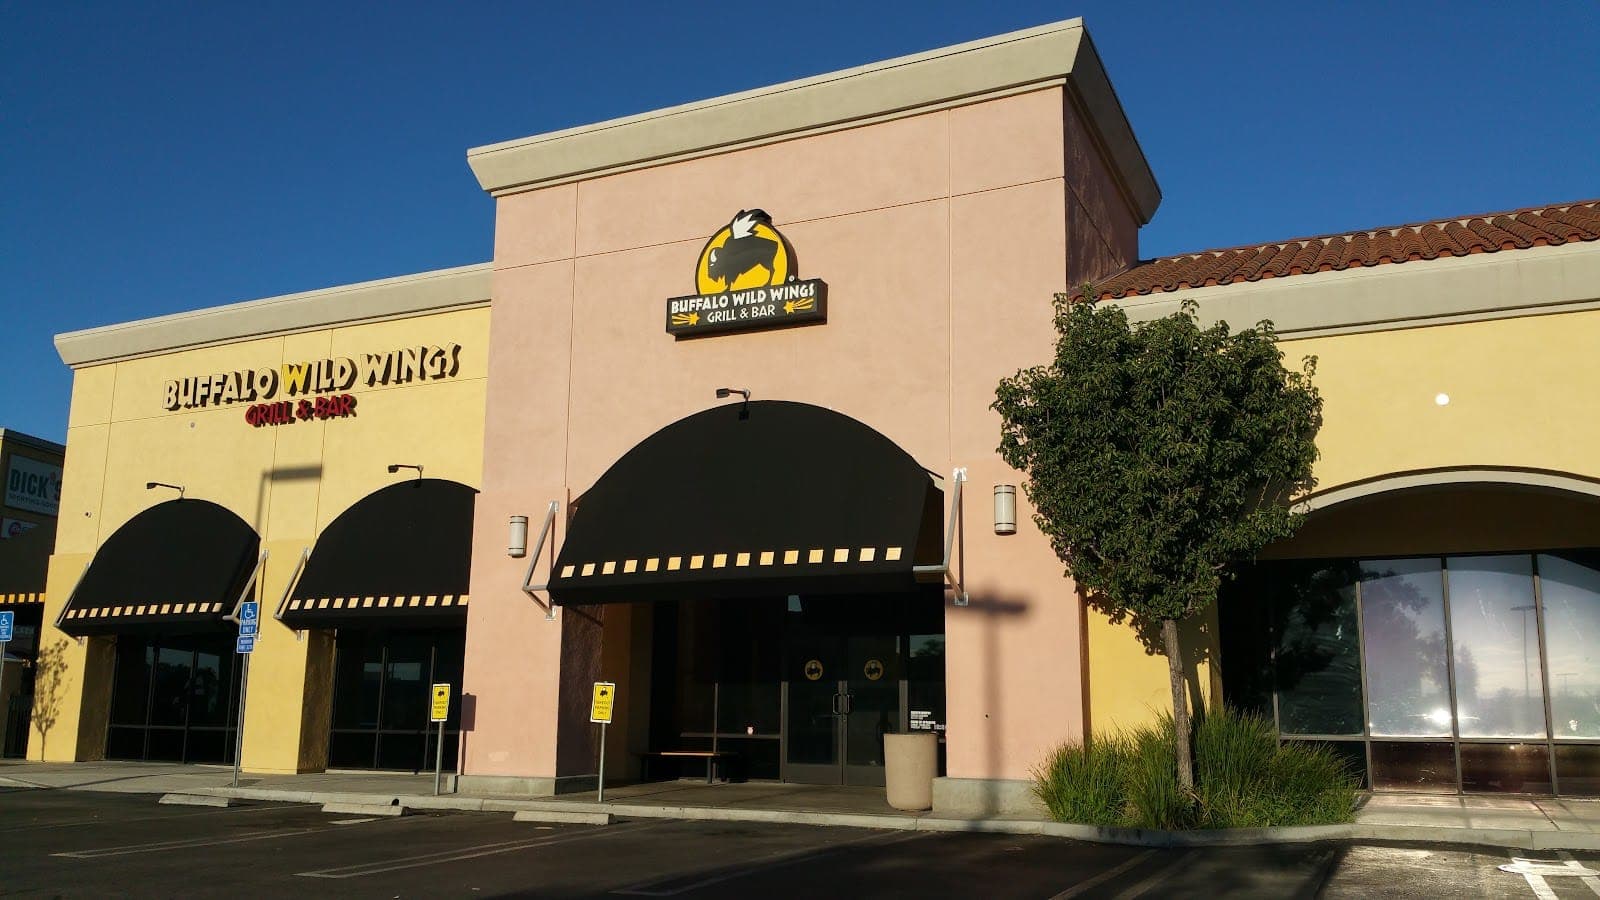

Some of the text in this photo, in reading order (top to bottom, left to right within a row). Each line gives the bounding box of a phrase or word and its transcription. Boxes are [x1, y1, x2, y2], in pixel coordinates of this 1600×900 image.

[671, 283, 815, 314] BUFFALO WILD WINGS
[707, 305, 776, 323] GRILL & BAR
[162, 342, 461, 411] BUFFALO WILD WINGS
[245, 393, 358, 427] GRILL & BAR
